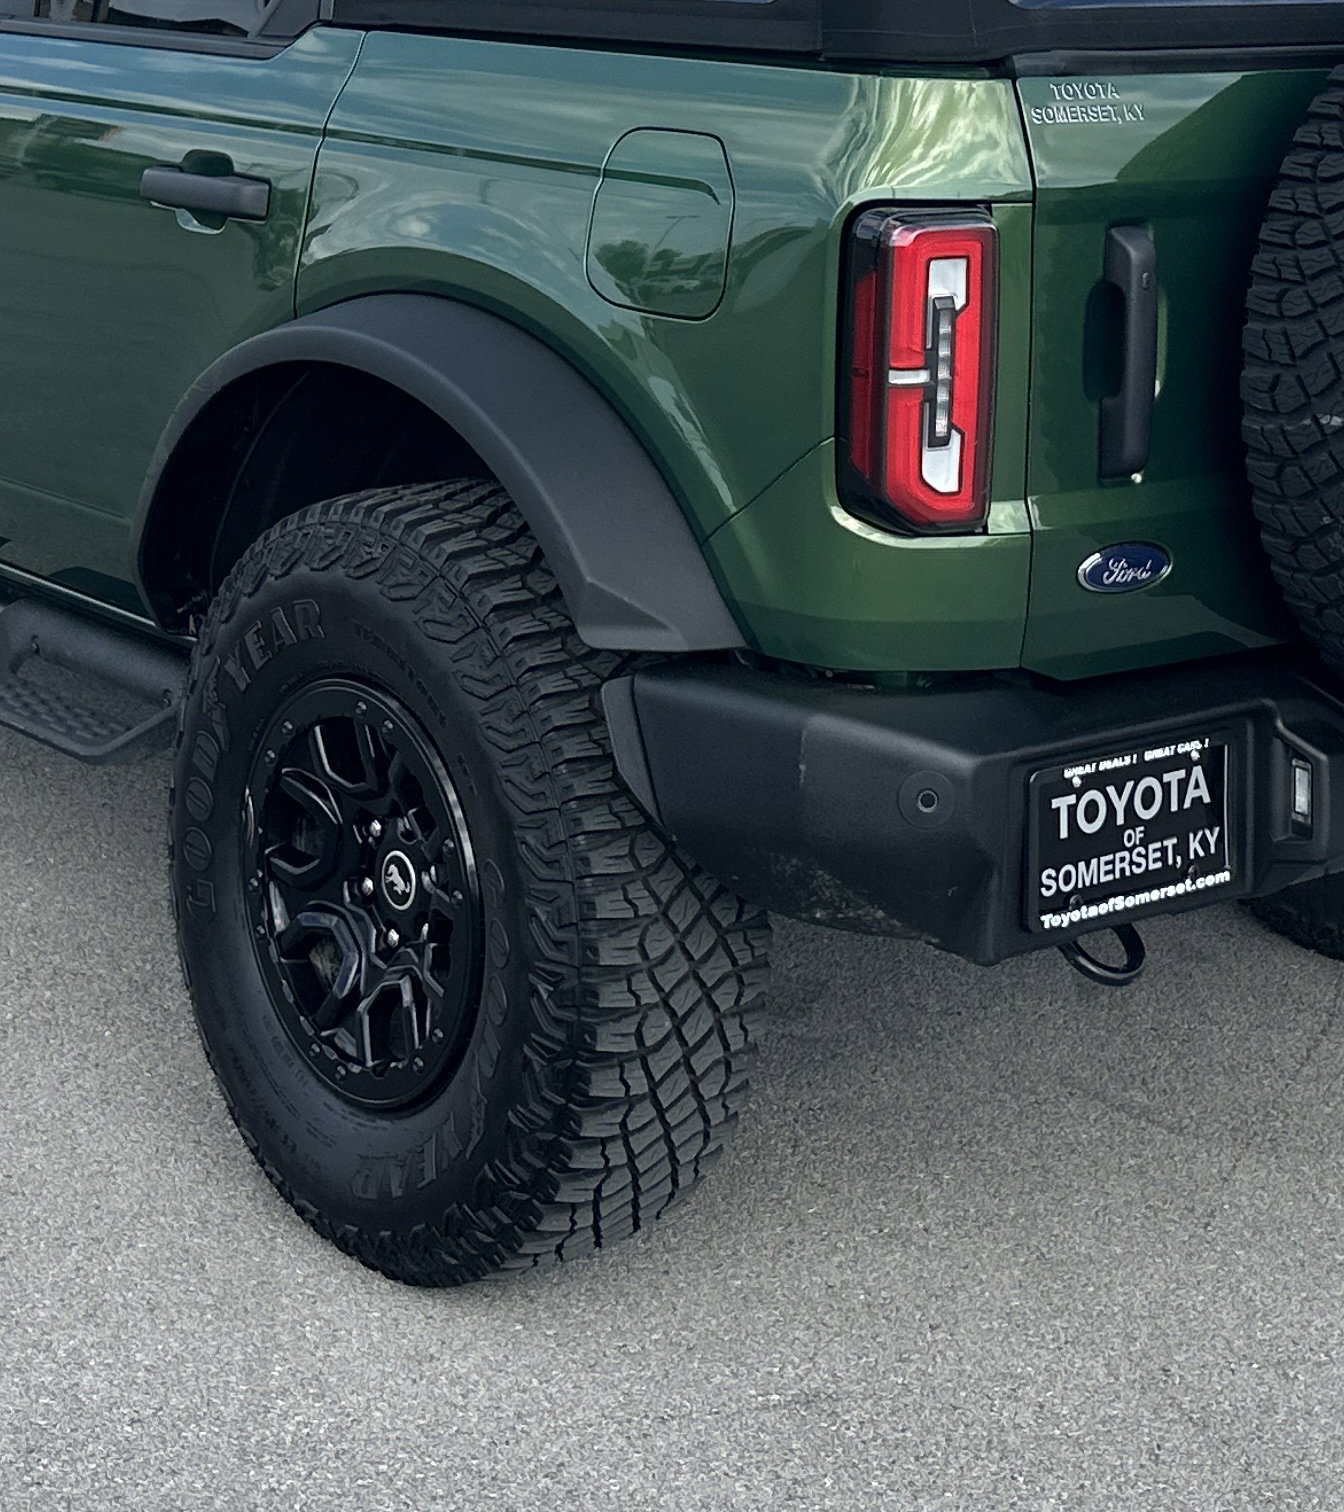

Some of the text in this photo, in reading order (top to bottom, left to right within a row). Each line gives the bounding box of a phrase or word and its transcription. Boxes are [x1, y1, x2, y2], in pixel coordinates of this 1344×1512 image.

[1049, 81, 1121, 101] TOYOTA
[1030, 103, 1145, 125] SOMERSET, KY
[1051, 764, 1211, 839] TOYOTA
[1123, 825, 1146, 848] OF
[1040, 826, 1221, 898] SOMERSET, KY
[1040, 869, 1232, 929] ToyotaofSomerset.com
